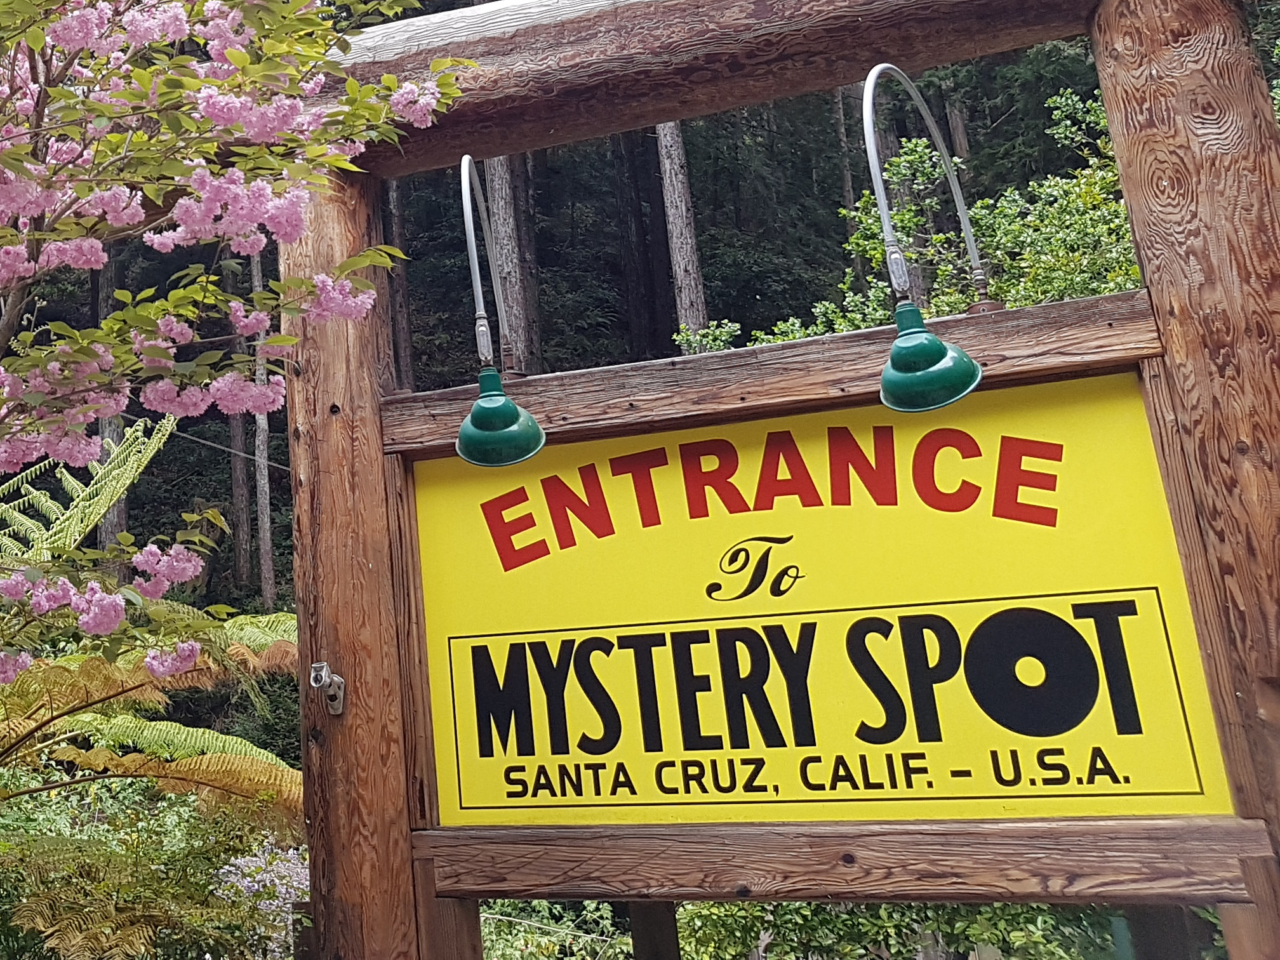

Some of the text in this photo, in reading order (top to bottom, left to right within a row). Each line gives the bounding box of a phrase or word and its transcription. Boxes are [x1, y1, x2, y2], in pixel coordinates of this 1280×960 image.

[480, 425, 1064, 573] ENTRANCE
[705, 534, 806, 602] To
[470, 599, 1144, 758] MYSTERY SPOT
[504, 762, 637, 799] SANTA
[654, 757, 780, 797] CRUZ,
[799, 752, 934, 791] CALIF.
[989, 746, 1131, 787] U.S.A.
